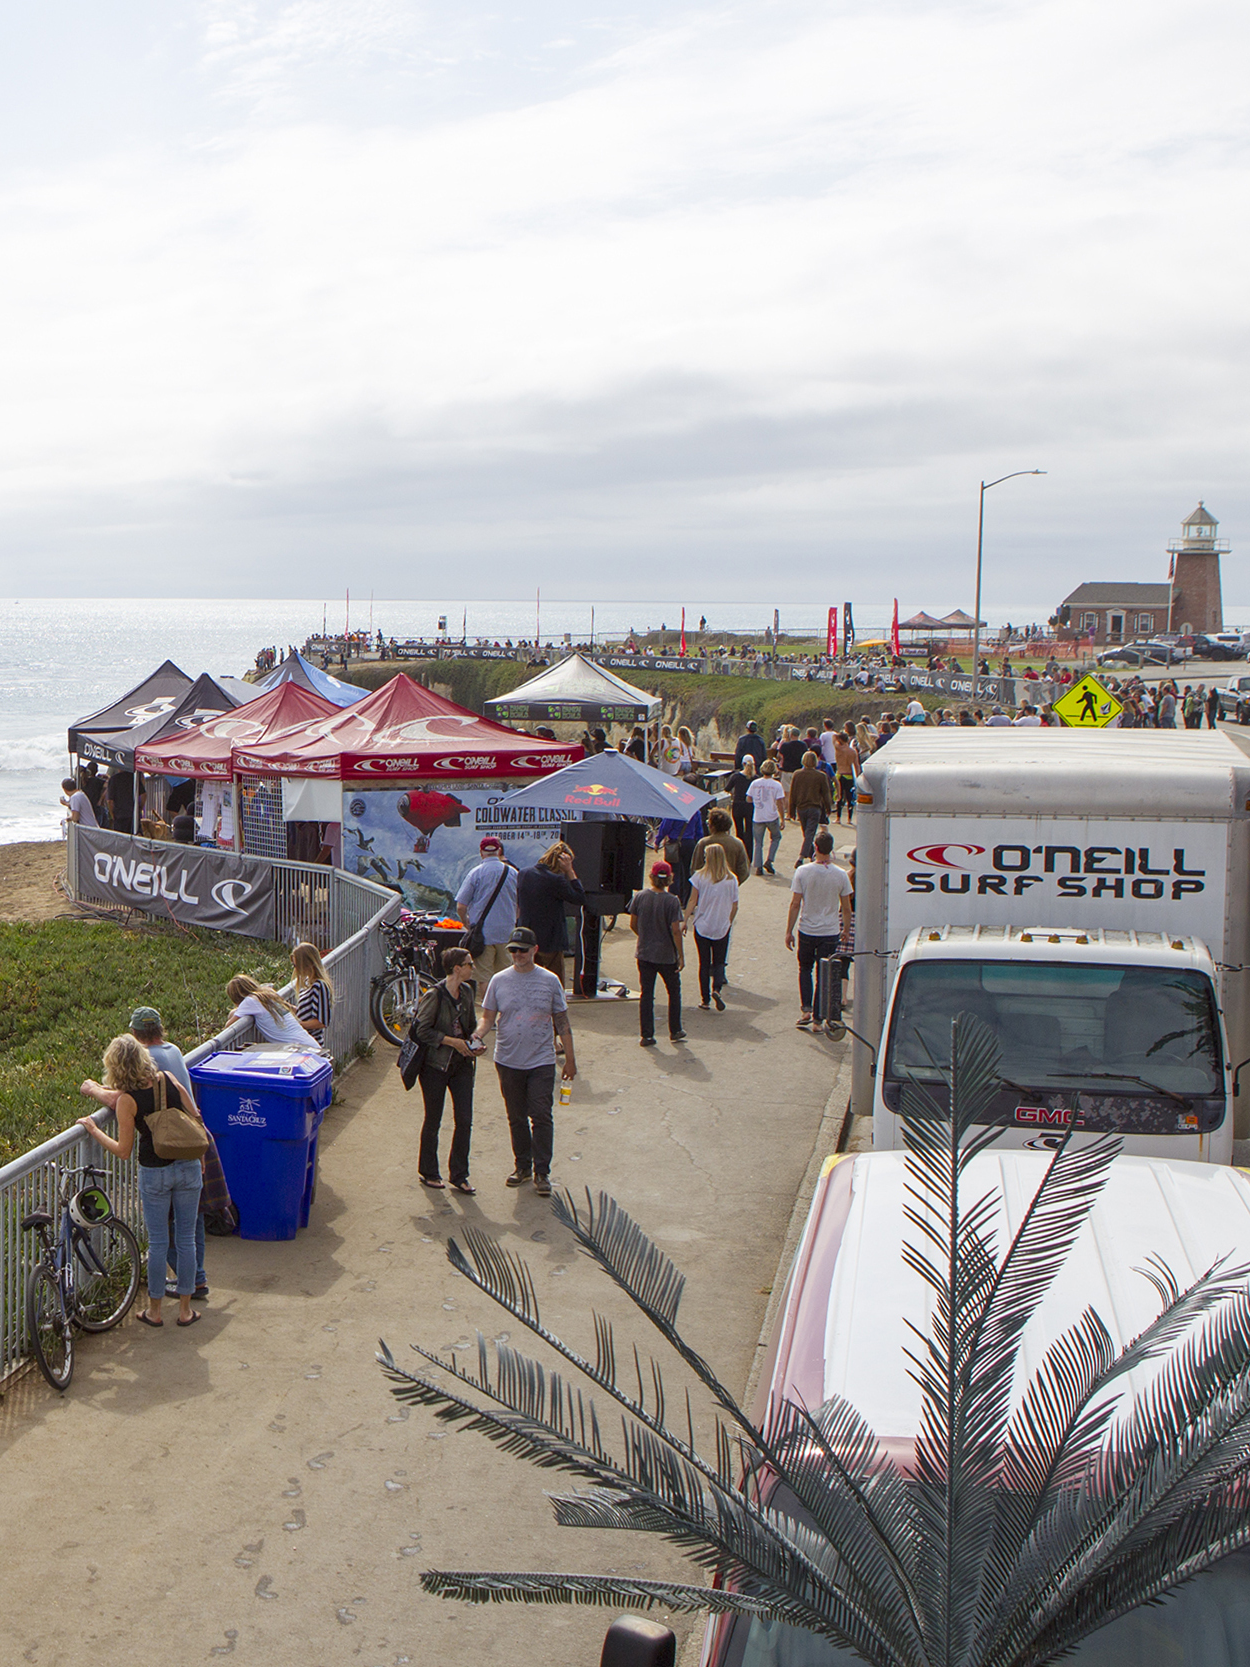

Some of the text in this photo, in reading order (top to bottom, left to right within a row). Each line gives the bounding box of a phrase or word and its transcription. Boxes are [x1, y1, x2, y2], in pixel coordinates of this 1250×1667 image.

[565, 795, 621, 807] Red Bull
[476, 807, 535, 823] COLDWATER
[992, 844, 1206, 877] O'NEILL
[94, 852, 199, 905] O'NEILL
[906, 872, 1205, 900] SURF SHOP
[1014, 1106, 1085, 1126] GMC
